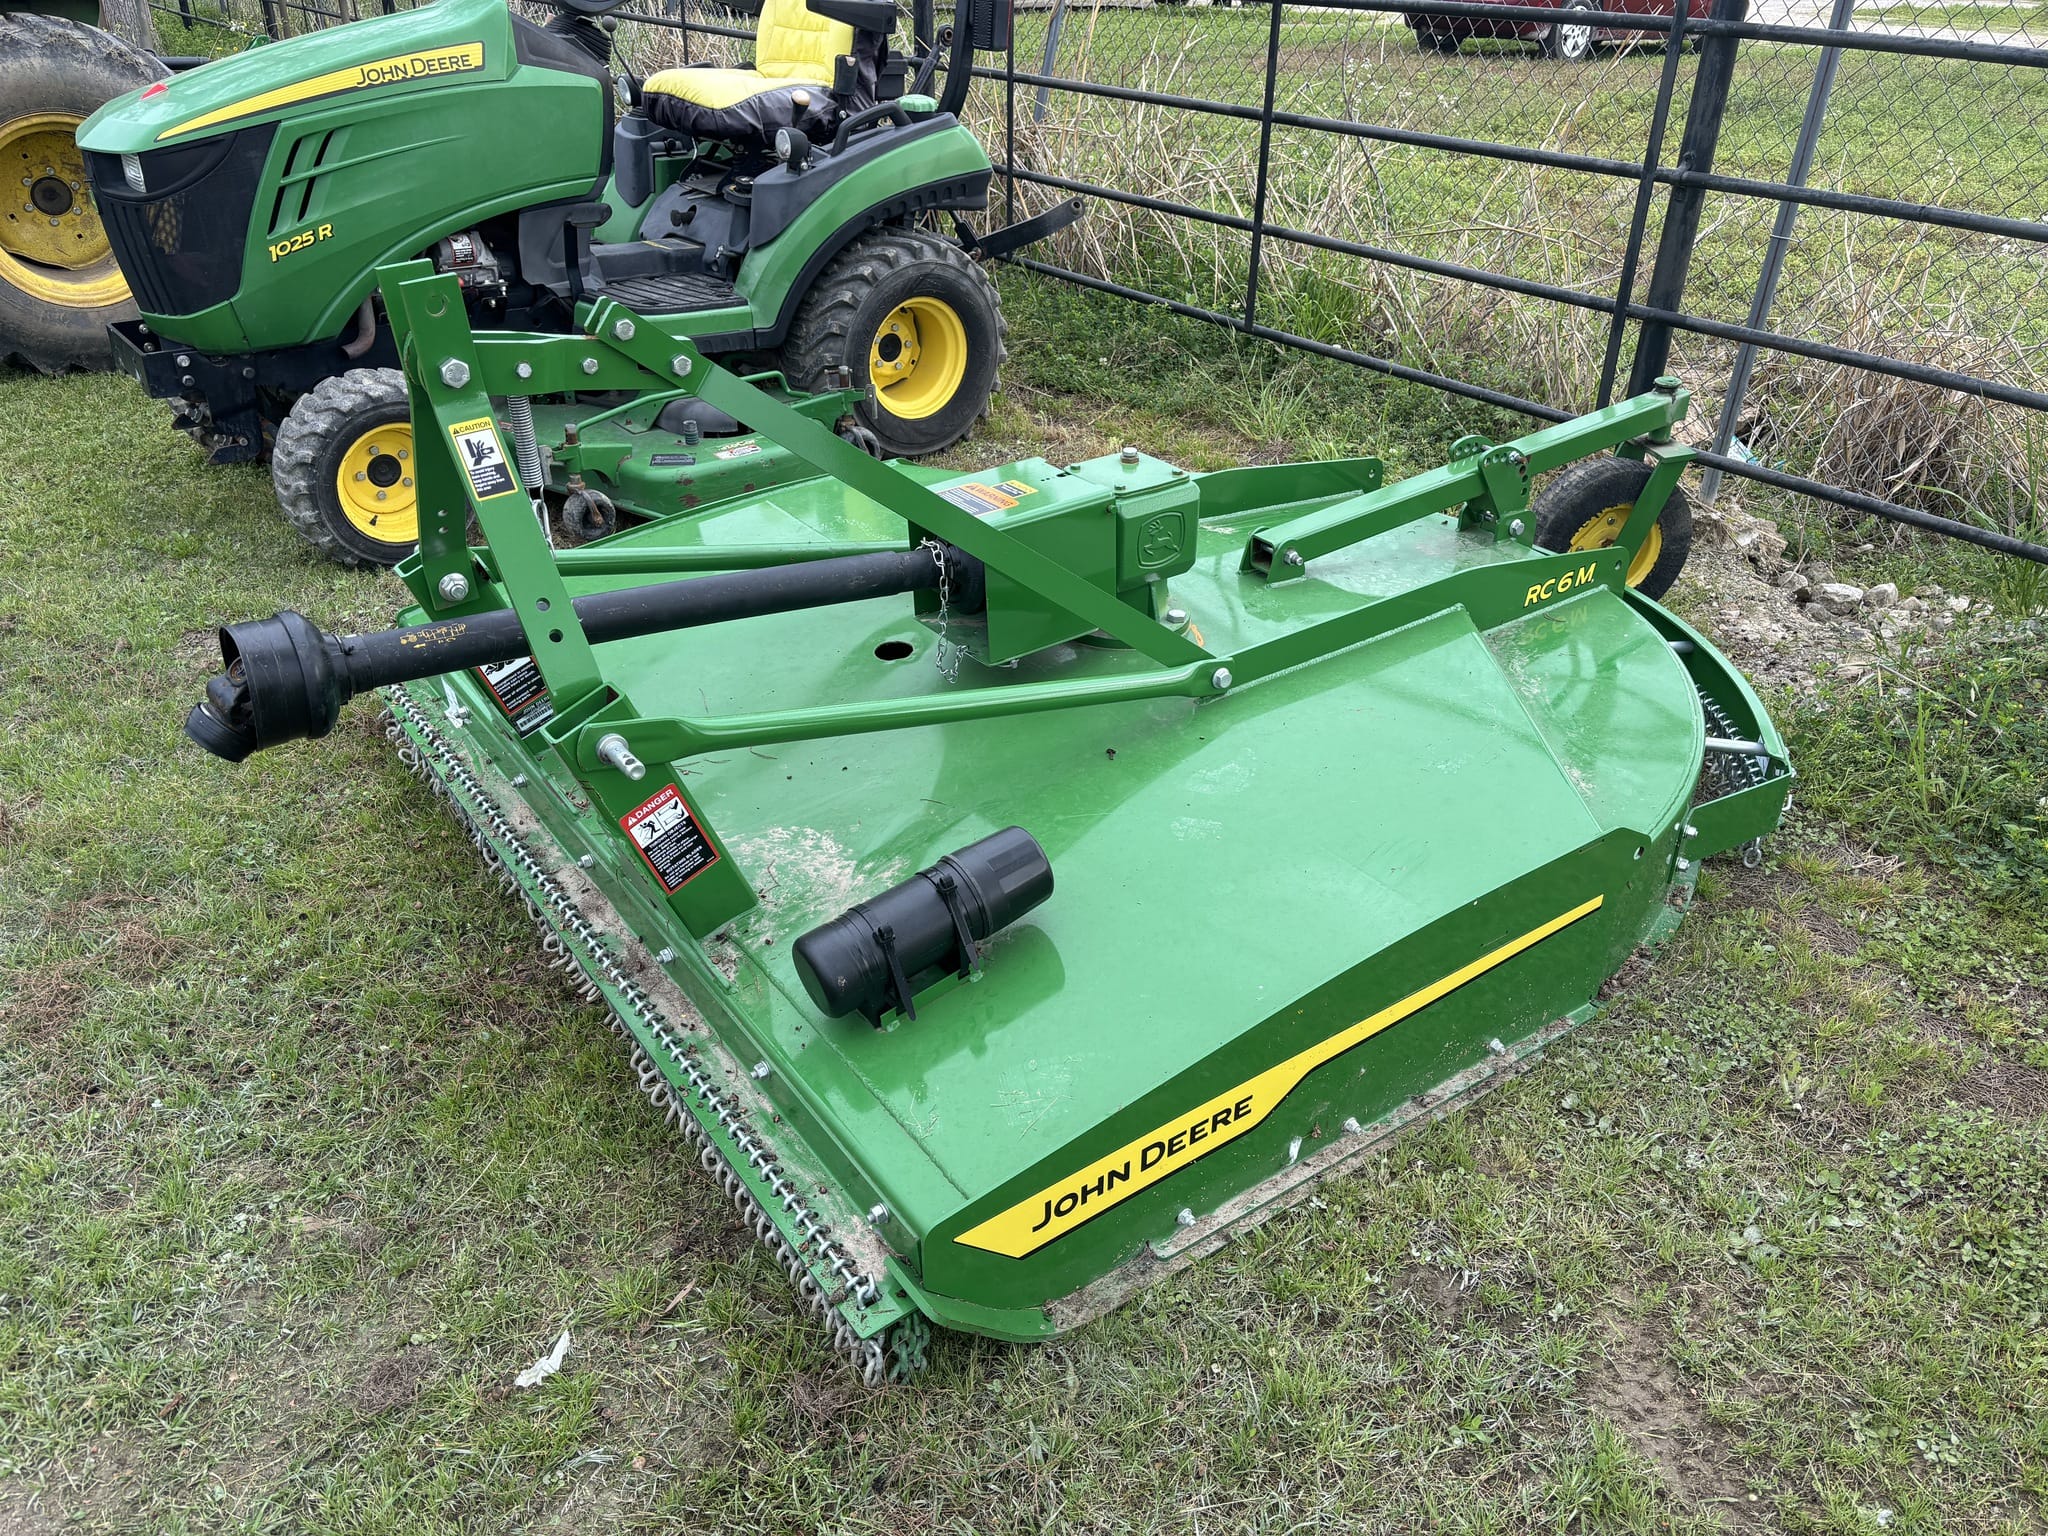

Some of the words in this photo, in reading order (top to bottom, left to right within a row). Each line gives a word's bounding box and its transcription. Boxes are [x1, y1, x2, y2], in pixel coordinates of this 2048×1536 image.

[356, 63, 409, 86] JOHN
[410, 54, 473, 75] DEERE
[268, 230, 315, 262] 1025
[318, 223, 333, 241] R
[459, 420, 491, 433] CAUTION
[635, 788, 674, 819] DANGER
[1032, 1160, 1131, 1233] JOHN
[1140, 1095, 1254, 1172] DEERE
